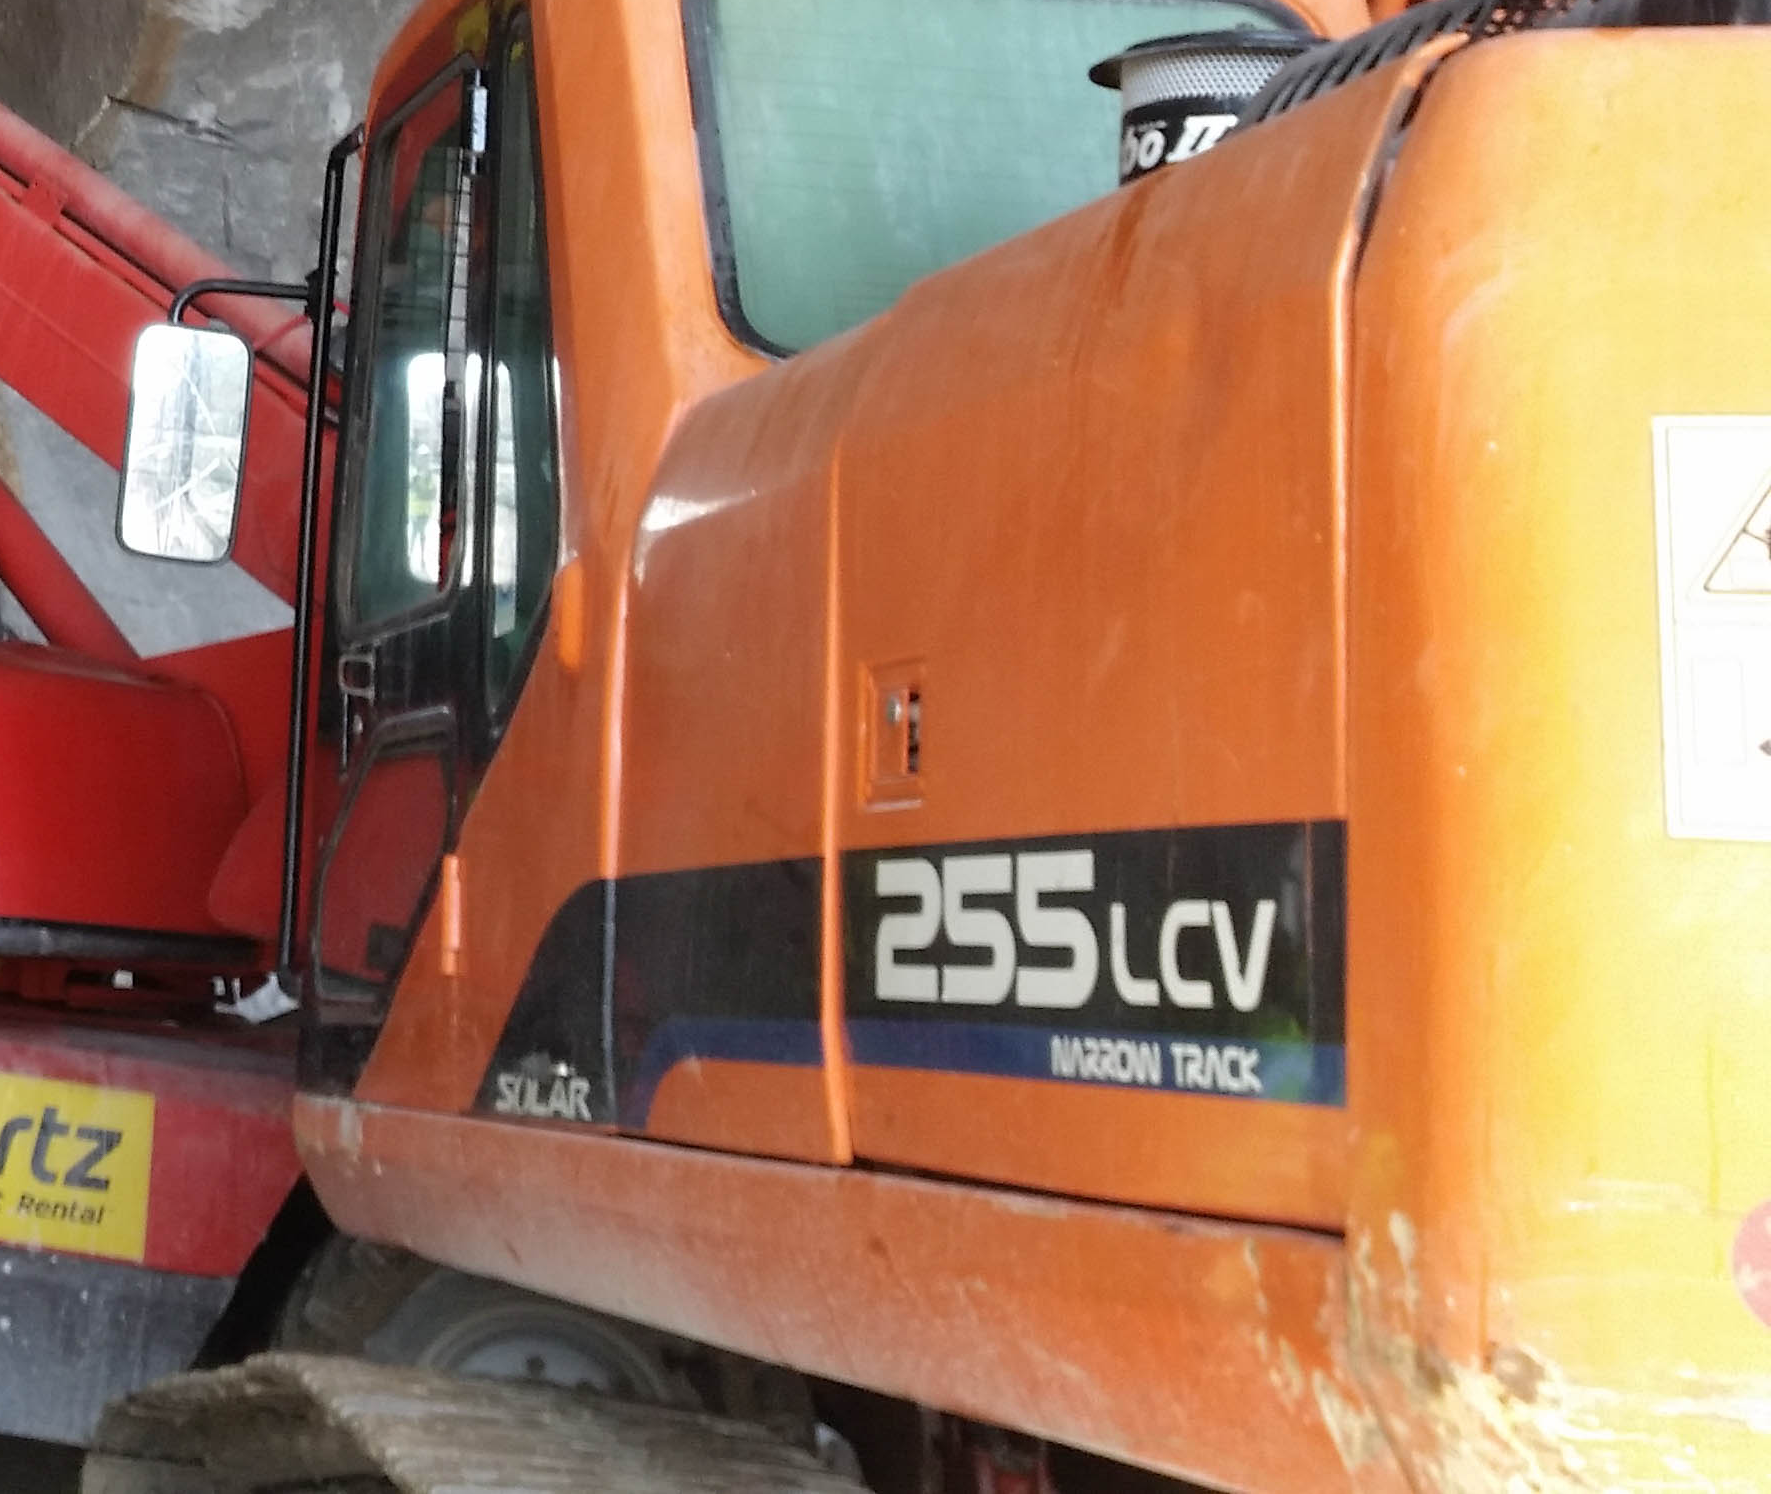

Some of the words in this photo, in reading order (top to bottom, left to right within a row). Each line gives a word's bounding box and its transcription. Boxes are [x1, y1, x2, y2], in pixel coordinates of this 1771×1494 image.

[1050, 1034, 1161, 1087] NARROW
[1170, 1042, 1262, 1095] TRACK
[16, 1193, 106, 1226] Rental
